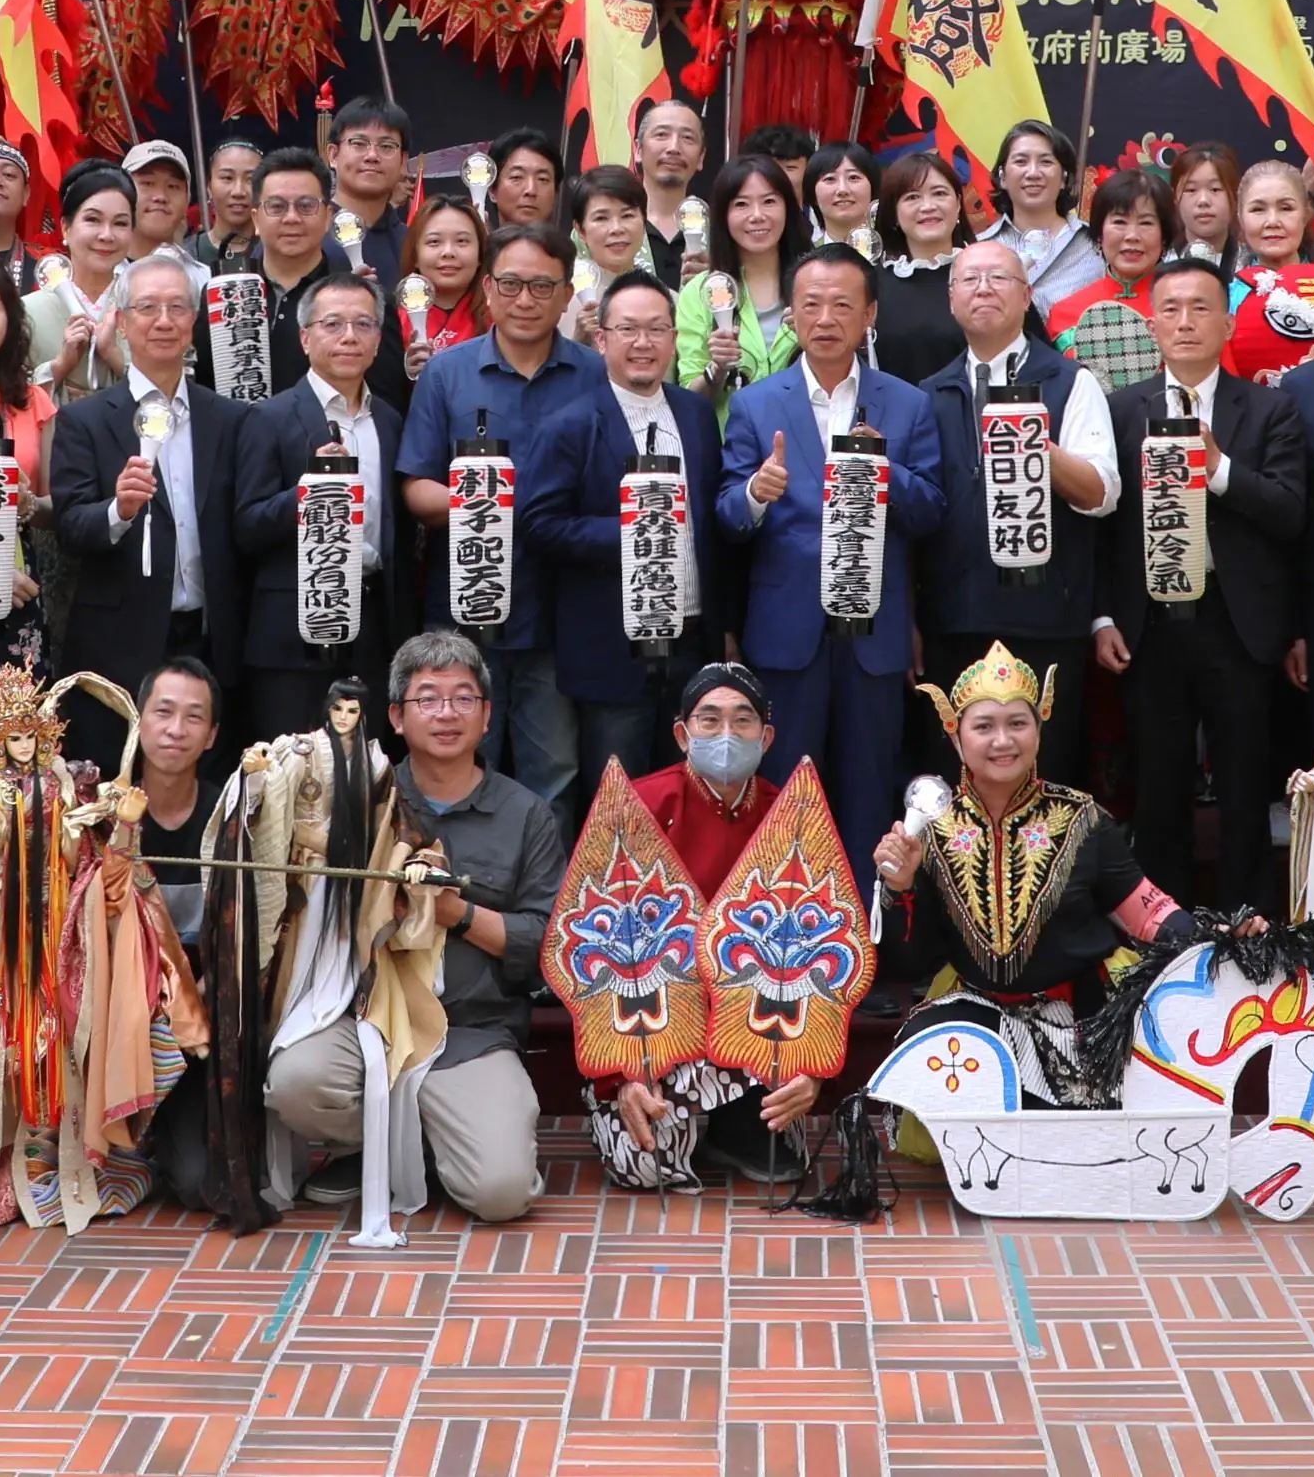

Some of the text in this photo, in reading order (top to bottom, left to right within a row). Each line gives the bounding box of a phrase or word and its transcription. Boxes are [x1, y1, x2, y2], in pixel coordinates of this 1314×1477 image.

[302, 481, 354, 642] 三顧股份有限公司
[456, 465, 507, 622] 朴子配天宮
[988, 420, 1025, 557] 台日友好
[1022, 418, 1048, 554] 2026
[1146, 443, 1193, 595] 萬士益冷氣
